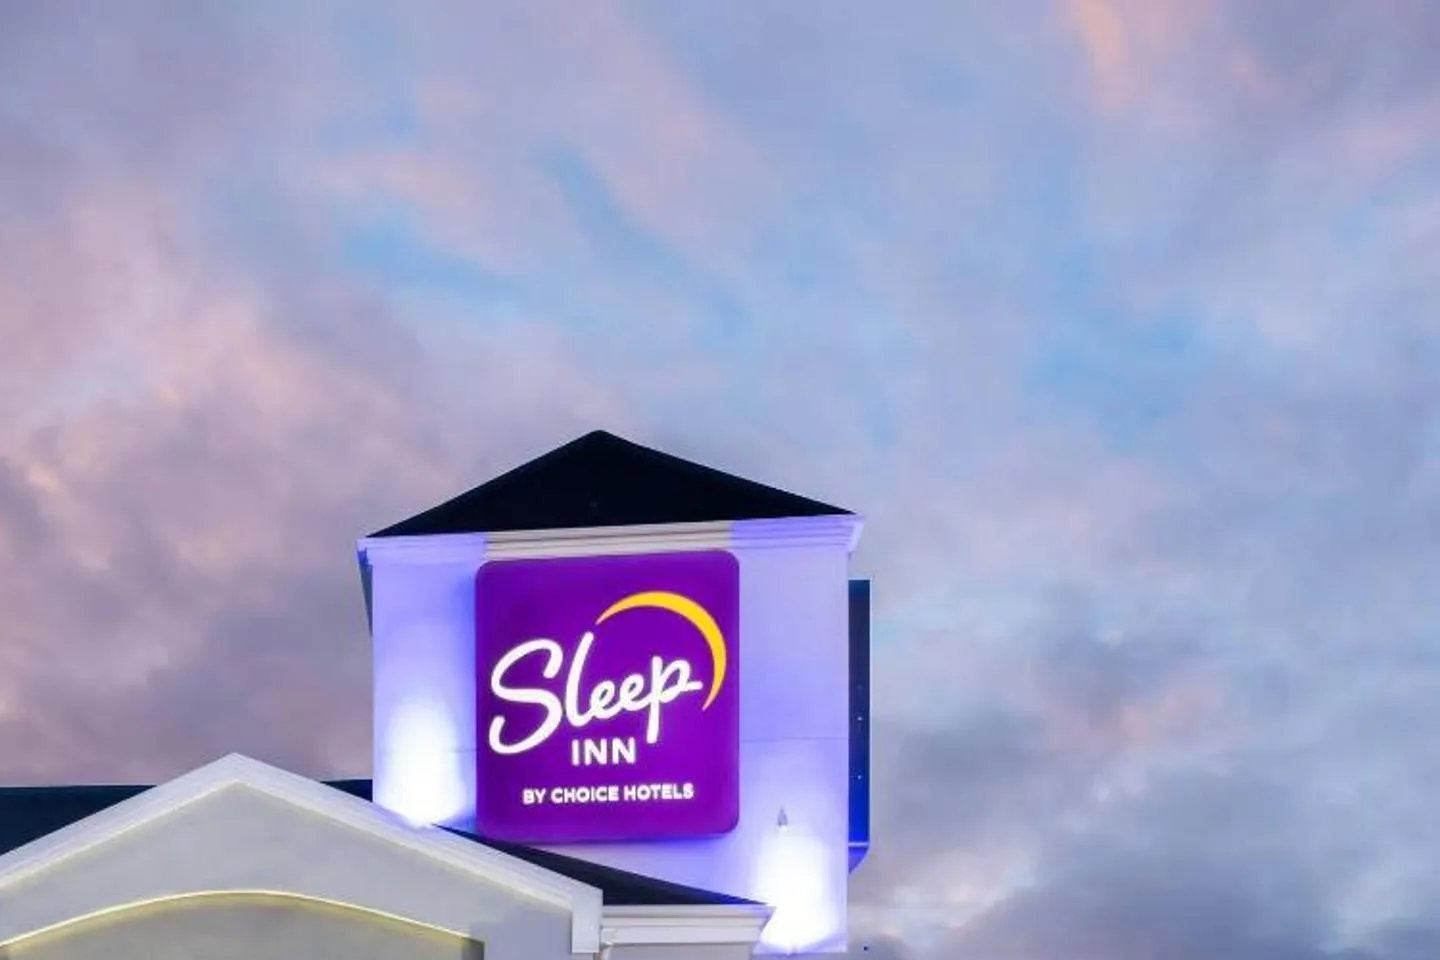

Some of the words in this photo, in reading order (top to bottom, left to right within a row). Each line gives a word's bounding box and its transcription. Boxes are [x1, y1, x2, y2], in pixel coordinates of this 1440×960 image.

[489, 631, 703, 754] Sleep
[572, 738, 637, 766] INN
[522, 788, 546, 805] BY
[551, 786, 619, 804] CHOICE
[624, 783, 694, 801] HOTELS
